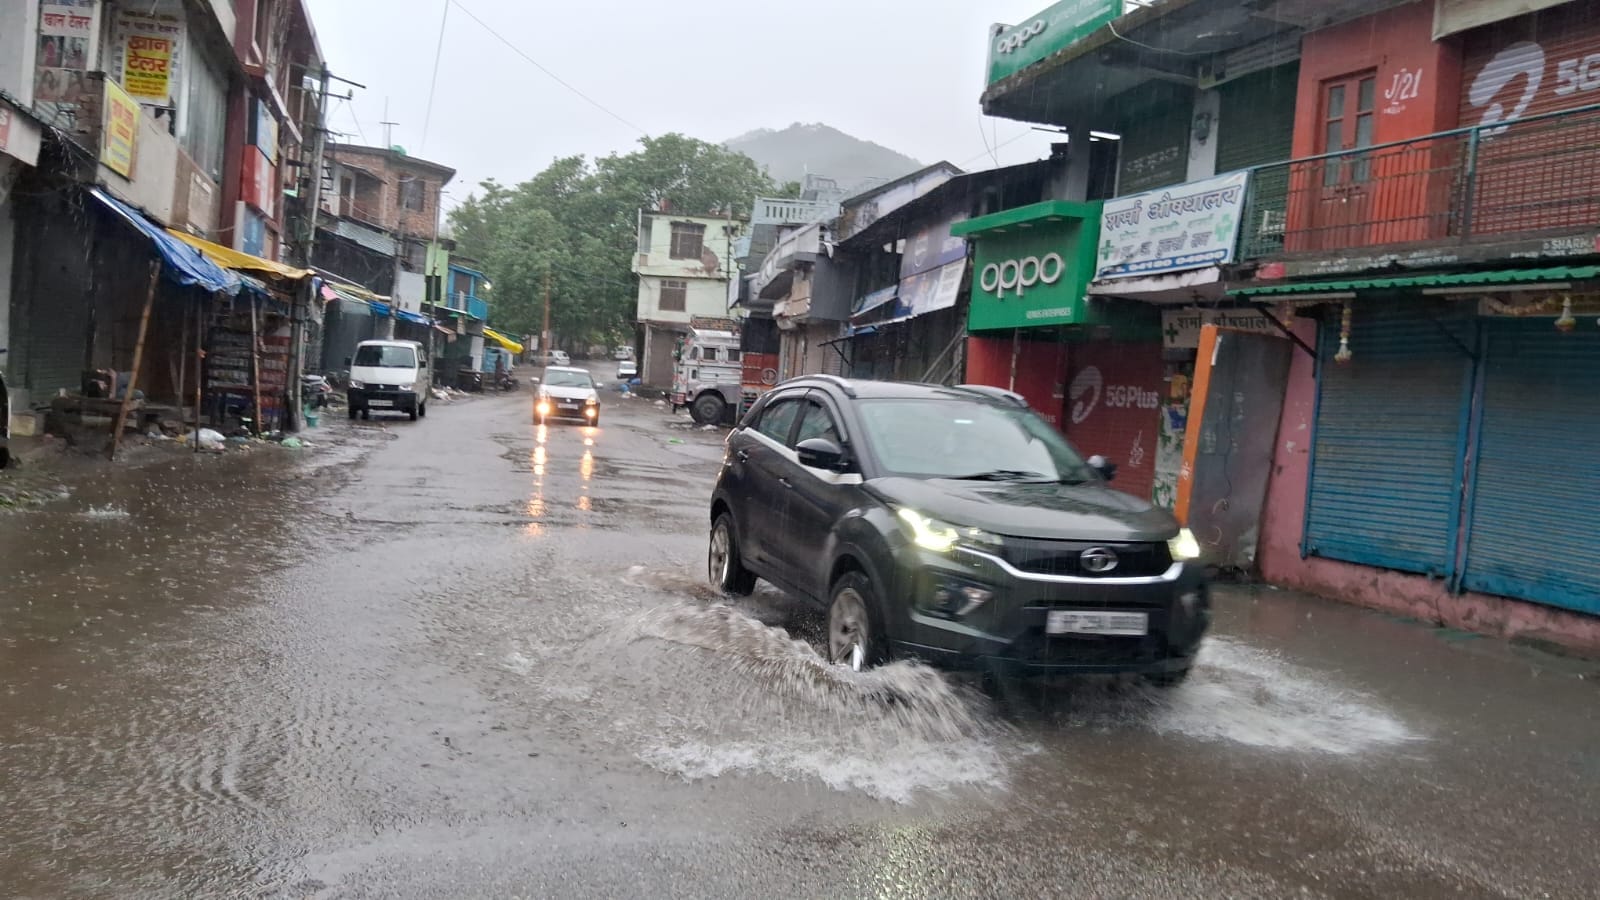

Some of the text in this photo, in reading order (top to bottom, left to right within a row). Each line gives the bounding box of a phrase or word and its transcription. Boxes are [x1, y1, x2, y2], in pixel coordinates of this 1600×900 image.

[44, 10, 92, 30] खान टेलर
[127, 36, 169, 52] खान
[997, 20, 1047, 53] oppo
[127, 51, 168, 73] टेलर
[1105, 200, 1142, 231] शर्मा
[1147, 184, 1242, 220] औषधालय
[980, 252, 1064, 298] oppo
